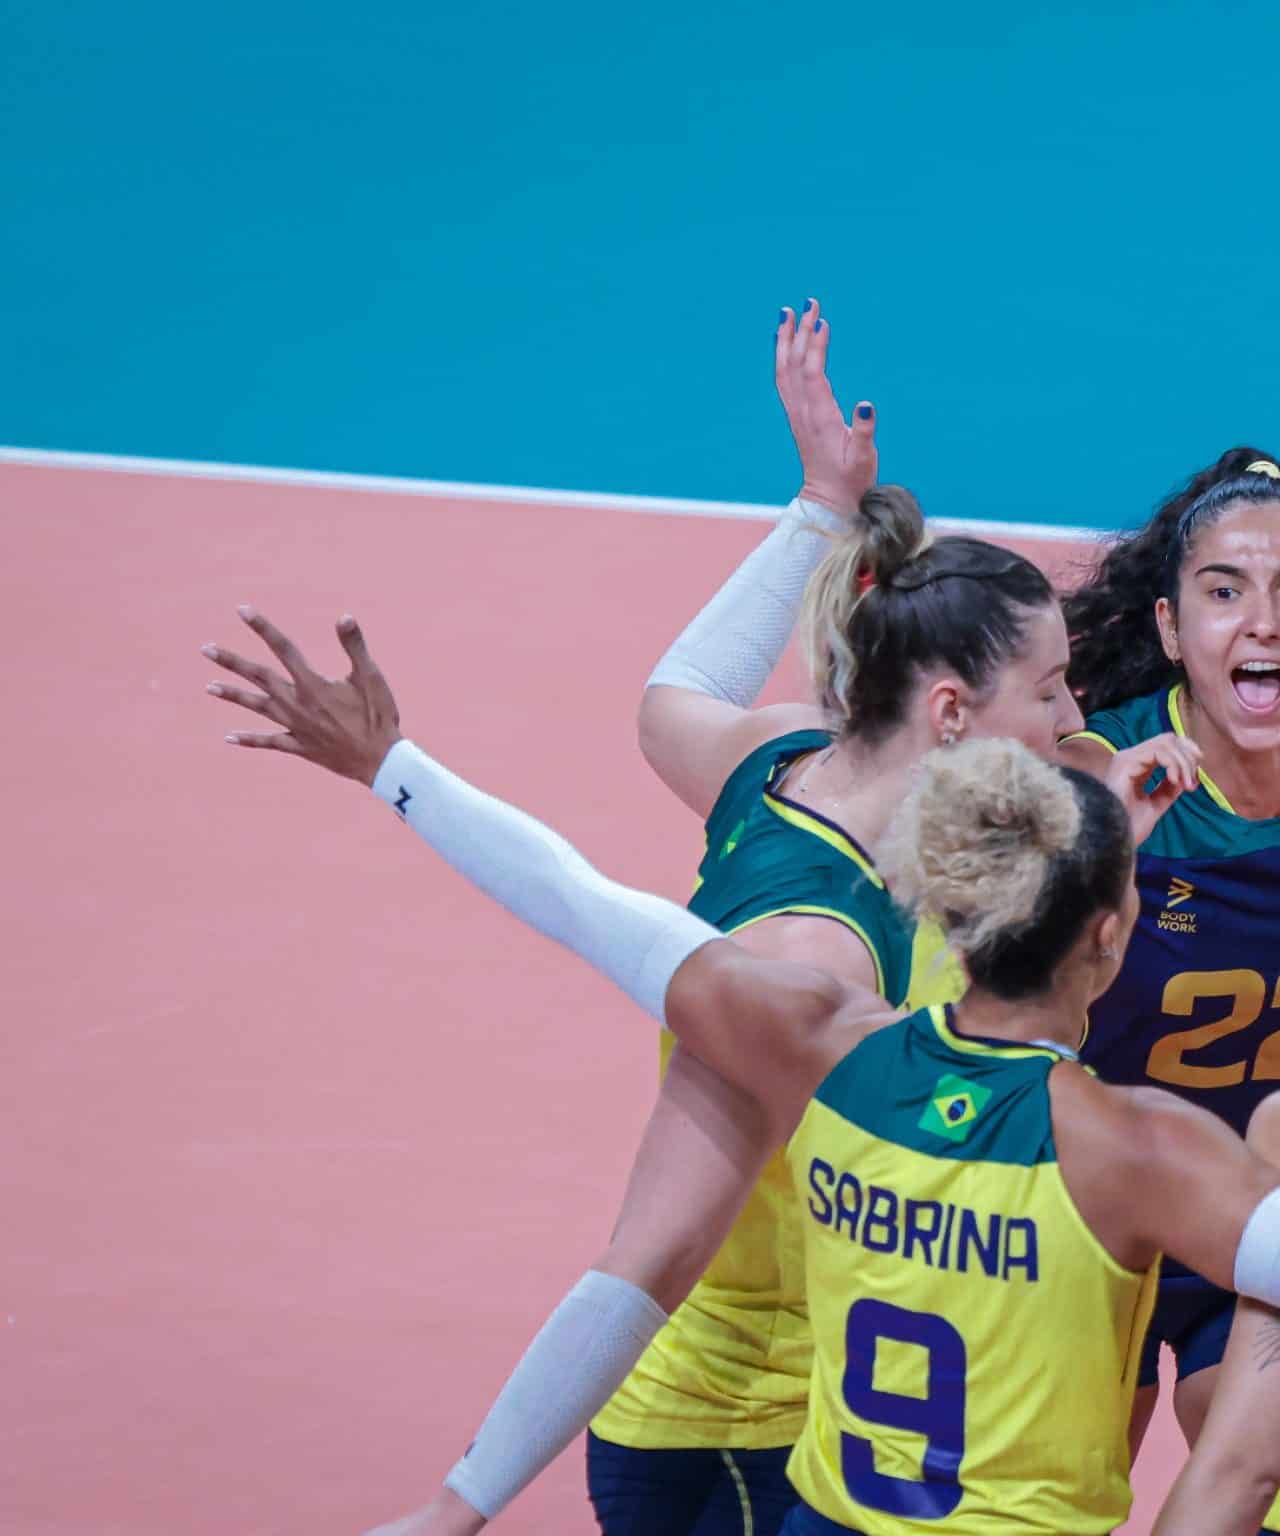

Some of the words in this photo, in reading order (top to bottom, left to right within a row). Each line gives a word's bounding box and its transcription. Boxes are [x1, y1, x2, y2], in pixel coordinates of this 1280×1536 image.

[1157, 919, 1198, 933] WORK
[1160, 911, 1197, 922] BODY
[808, 1157, 1040, 1283] SABRINA
[840, 1298, 967, 1520] 9
